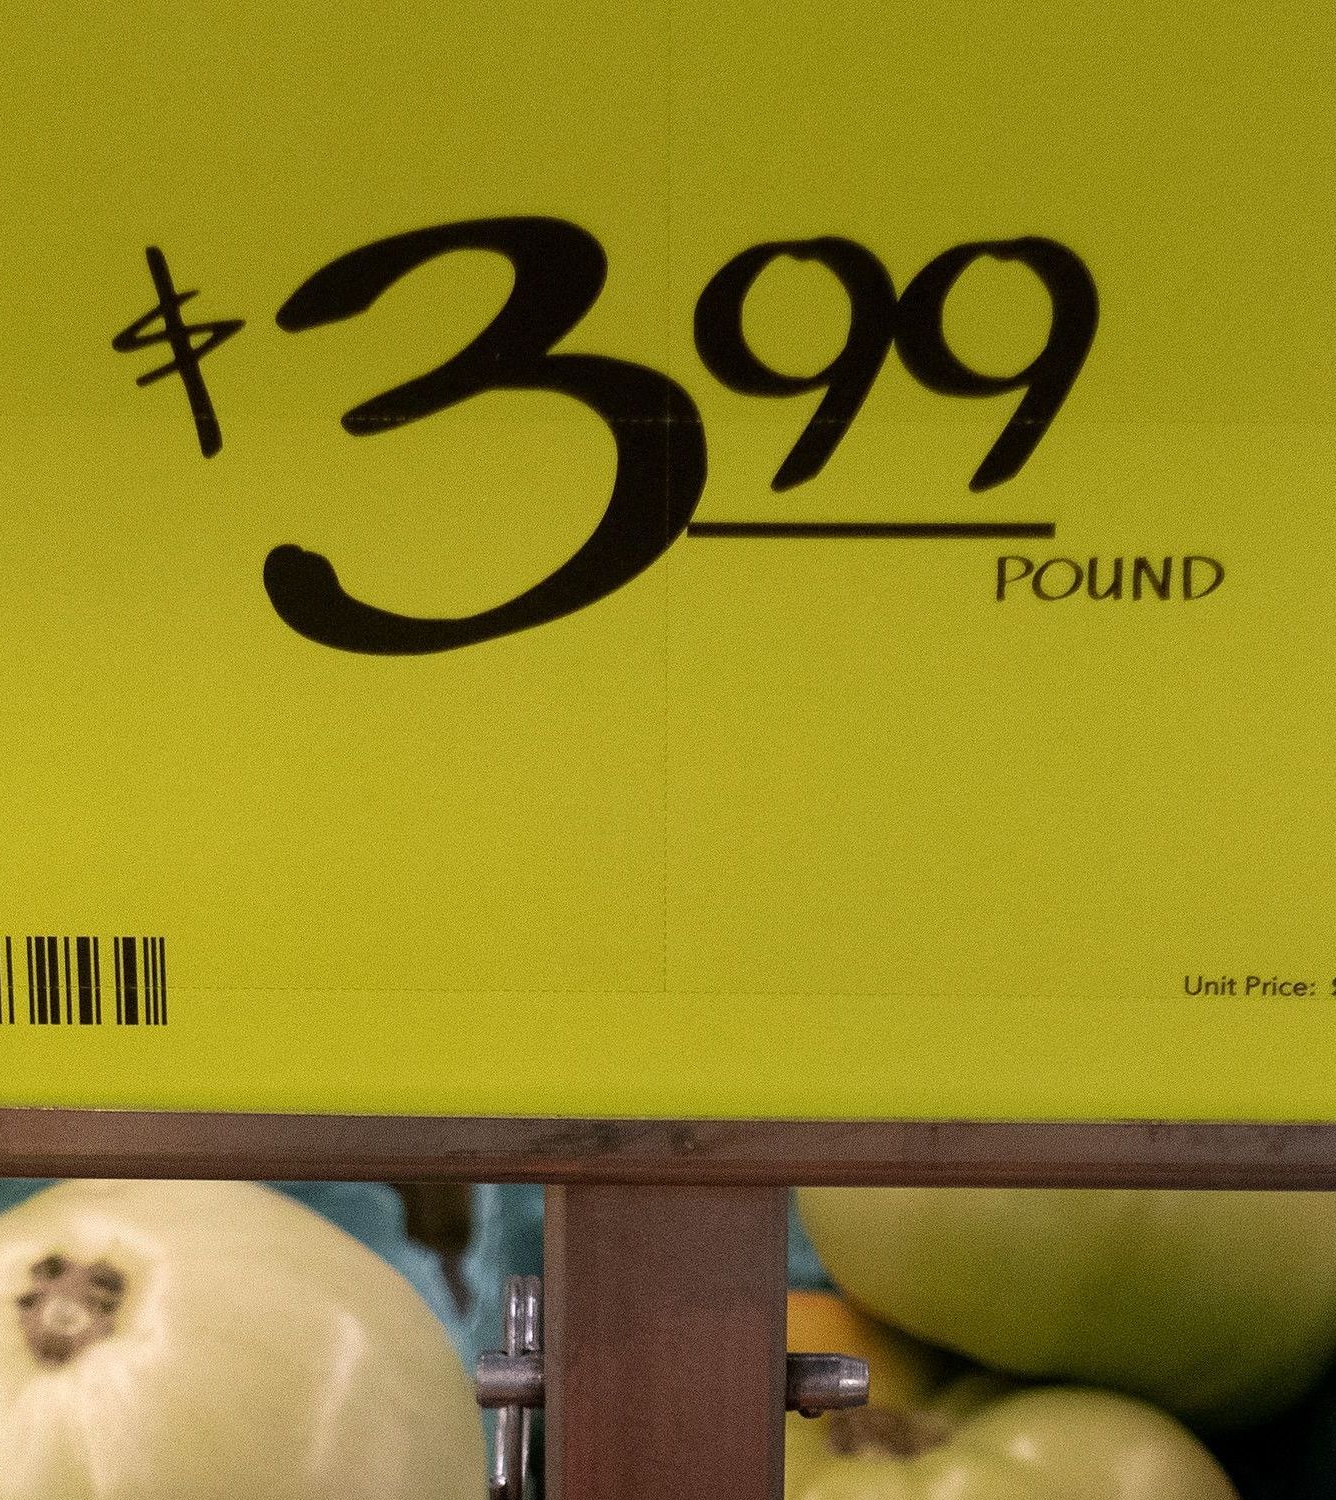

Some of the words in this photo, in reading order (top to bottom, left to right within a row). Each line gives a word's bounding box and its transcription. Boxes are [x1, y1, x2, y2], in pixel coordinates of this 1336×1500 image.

[996, 555, 1226, 602] POUND
[1183, 975, 1237, 997] Unit
[1244, 976, 1316, 998] Price:
